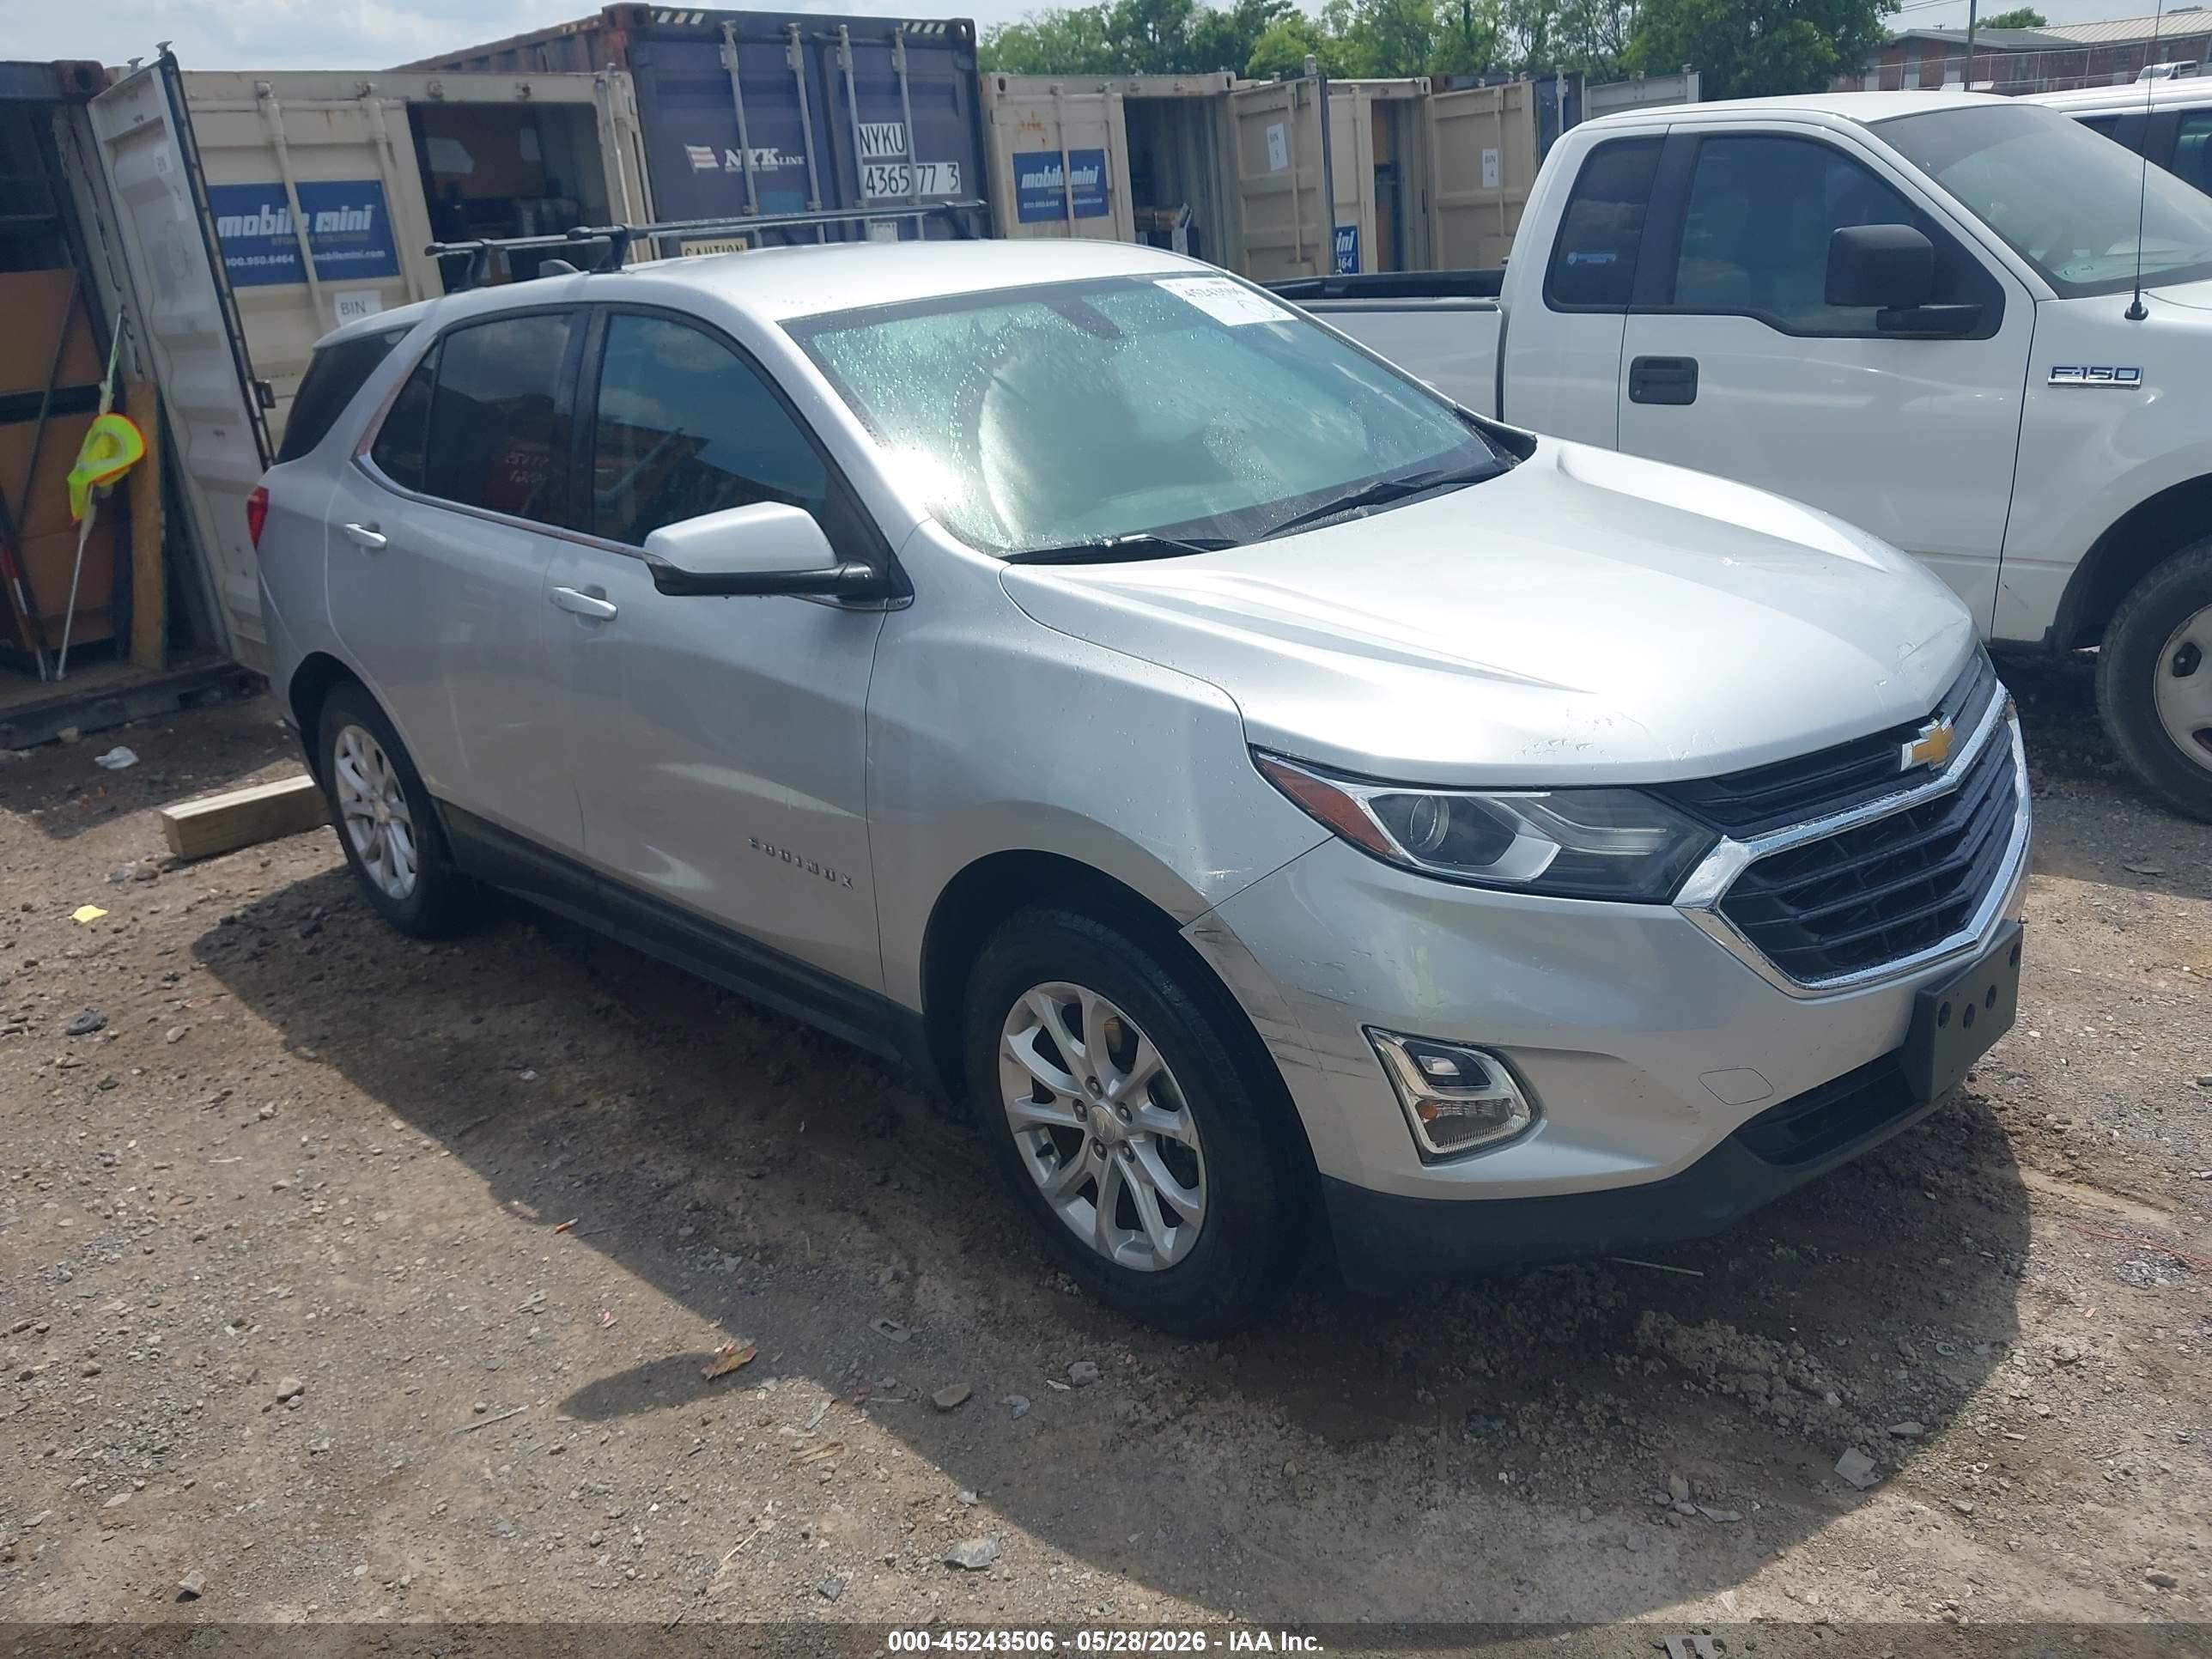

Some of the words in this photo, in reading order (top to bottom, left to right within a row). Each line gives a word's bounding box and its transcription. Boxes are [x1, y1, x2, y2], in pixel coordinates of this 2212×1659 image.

[859, 125, 906, 155] NYKU
[725, 148, 779, 167] NYK
[779, 155, 805, 166] LINE
[946, 164, 959, 191] 3
[217, 204, 310, 237] mobile
[315, 204, 372, 233] mini
[1336, 231, 1354, 252] ini
[340, 301, 366, 316] BIN
[748, 837, 854, 890] EQUINOX
